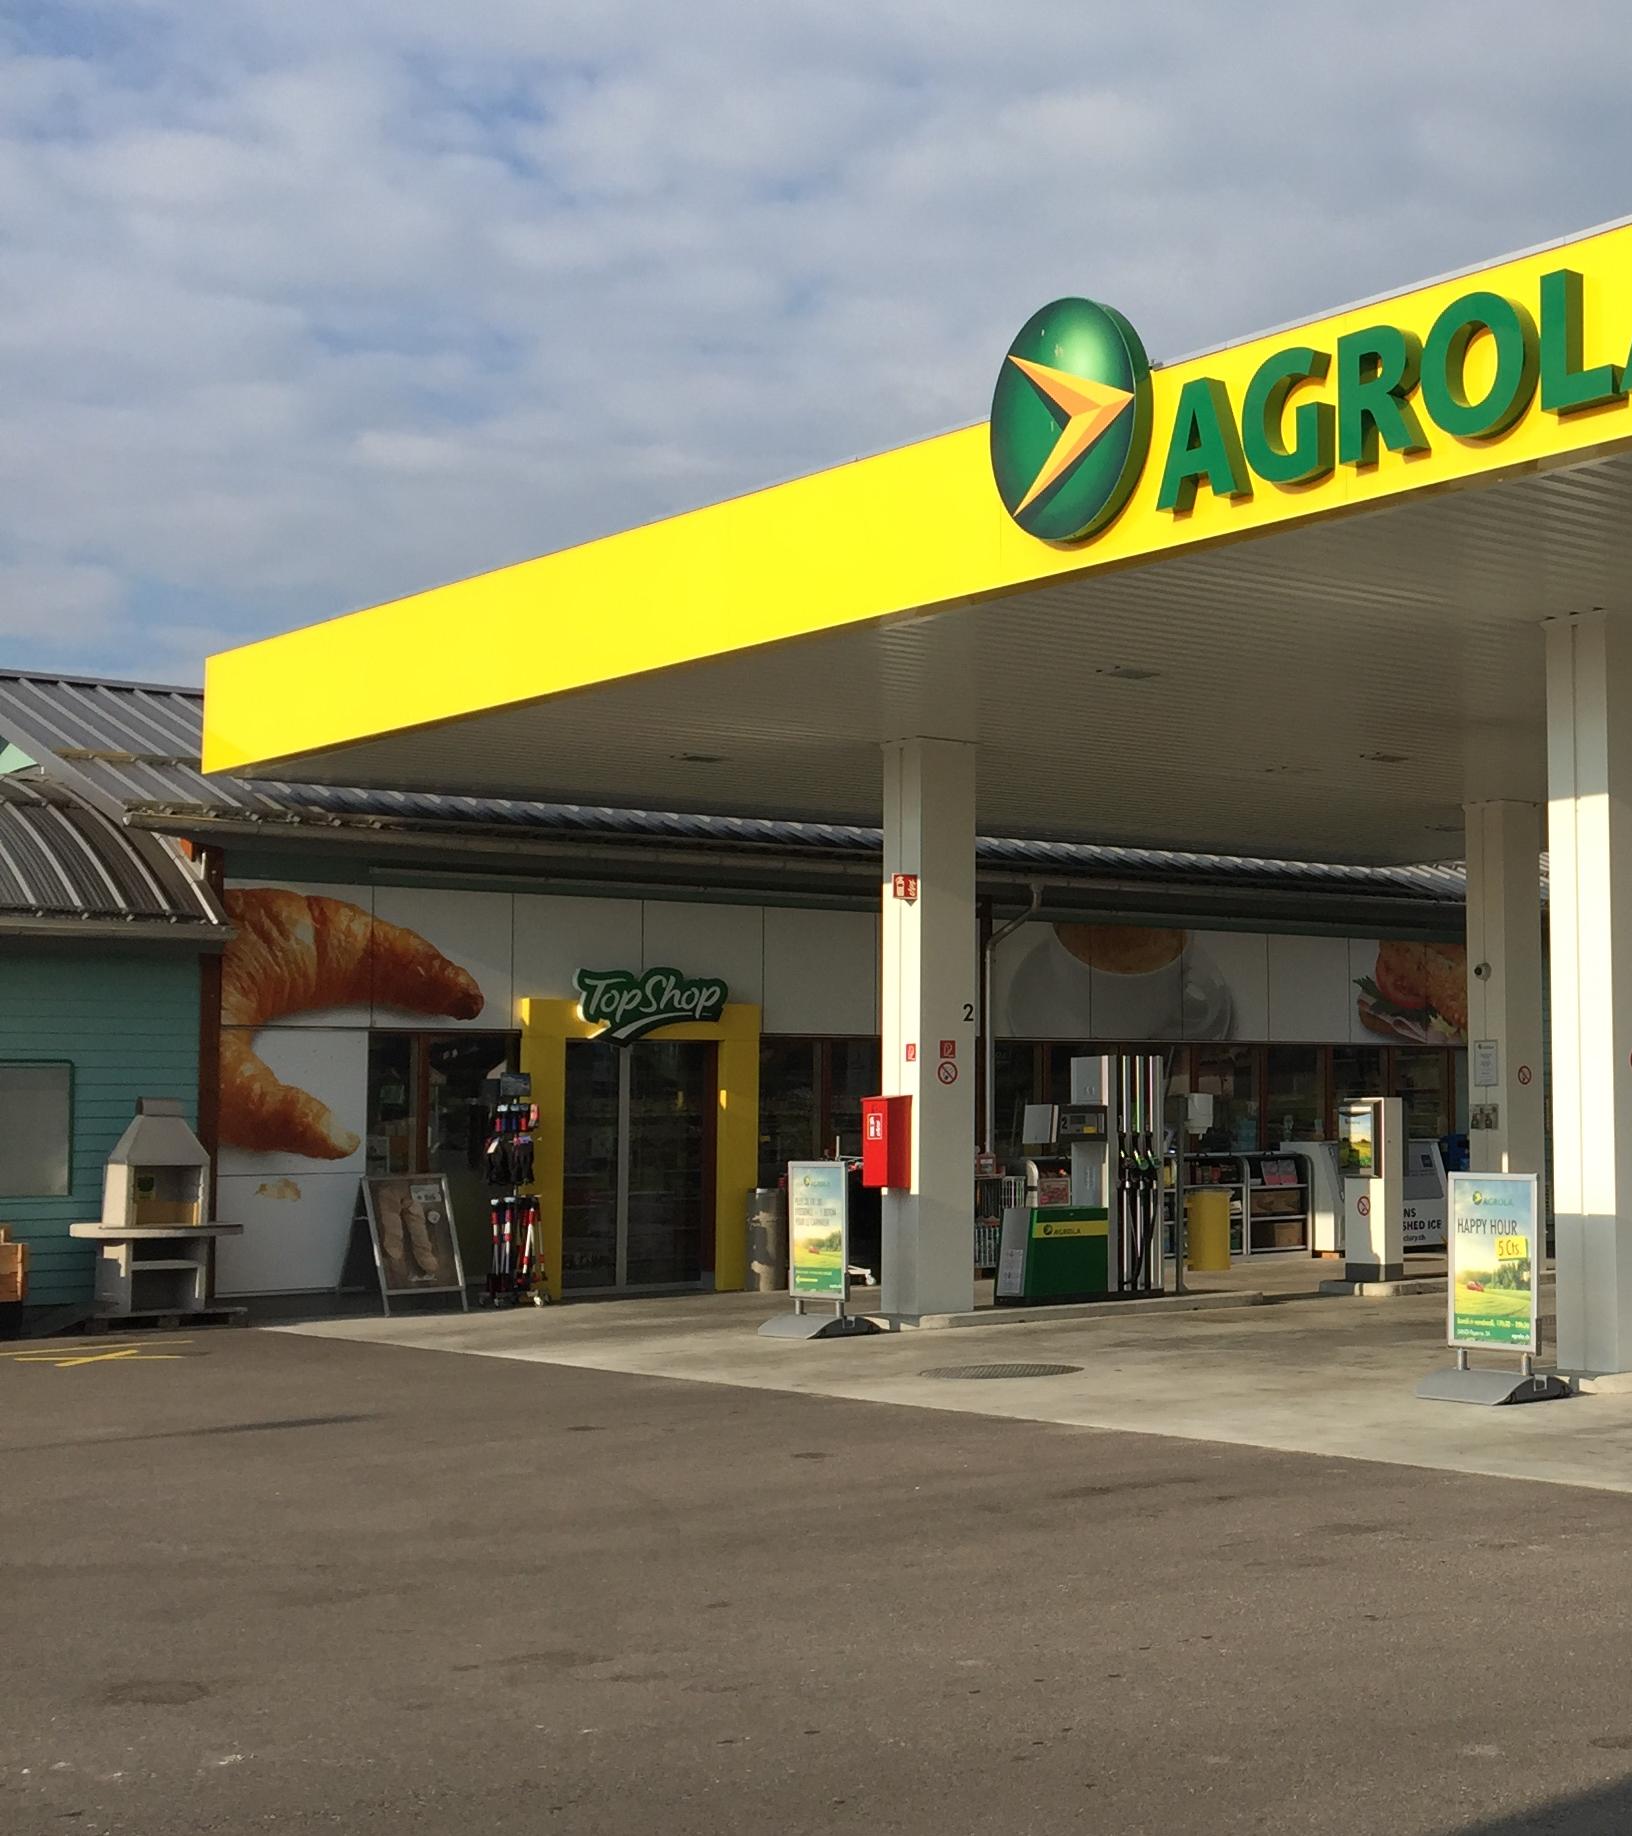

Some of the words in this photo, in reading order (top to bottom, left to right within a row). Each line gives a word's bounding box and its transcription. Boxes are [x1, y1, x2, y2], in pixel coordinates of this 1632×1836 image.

[583, 975, 721, 1022] TopShop
[963, 1003, 974, 1021] 2
[1427, 1219, 1442, 1230] ICE
[1457, 1218, 1487, 1235] HAPPY
[1490, 1219, 1518, 1236] HOUR
[1498, 1240, 1504, 1257] 5
